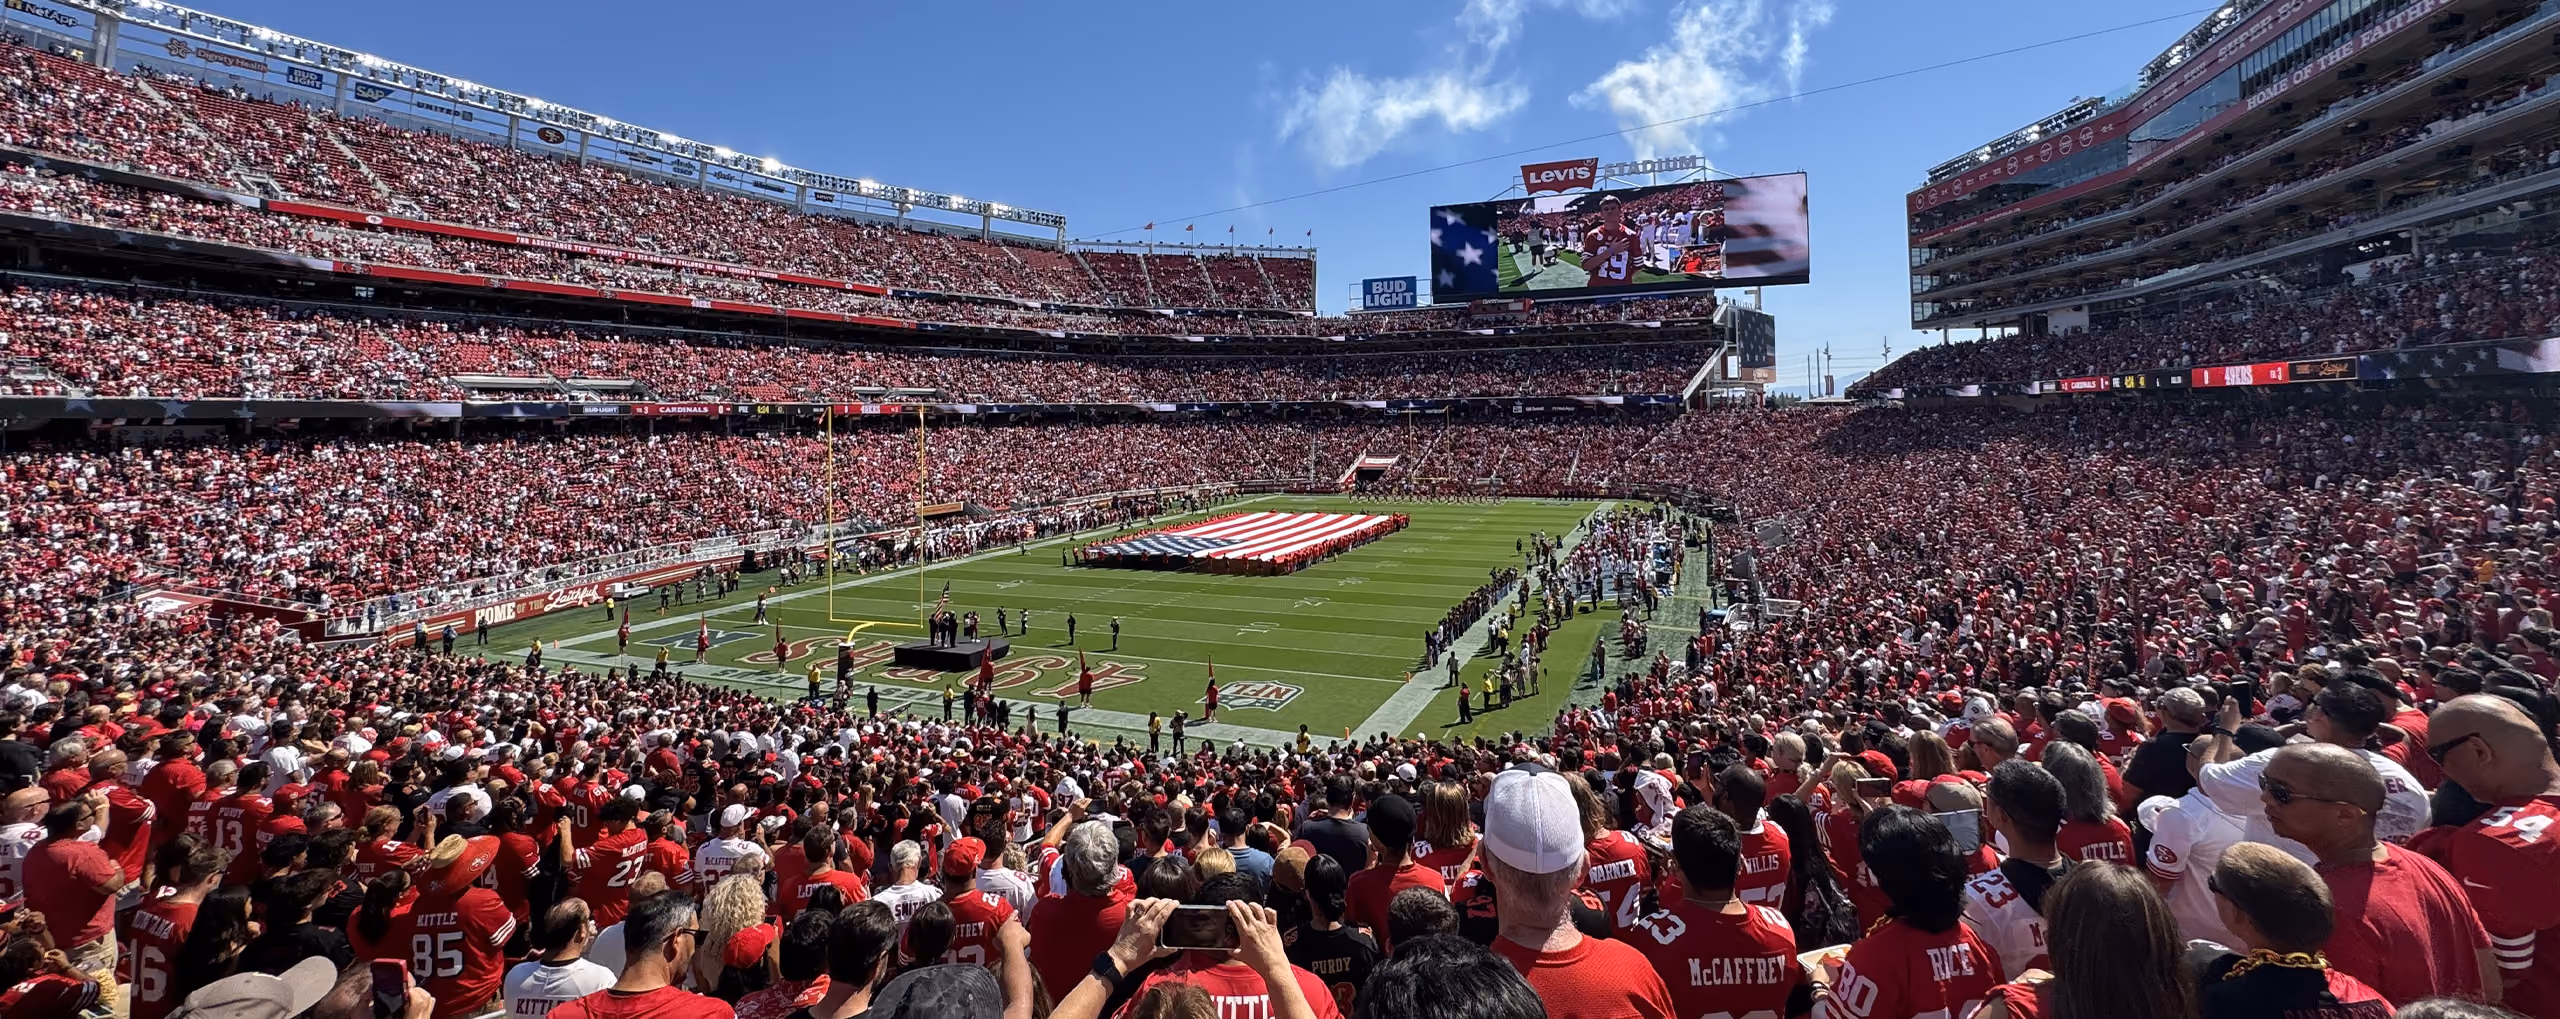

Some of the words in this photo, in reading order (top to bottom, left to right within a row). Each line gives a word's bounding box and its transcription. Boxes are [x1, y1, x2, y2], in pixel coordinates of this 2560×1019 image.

[25, 3, 78, 27] NetApp
[197, 50, 235, 67] Dignity
[235, 58, 268, 73] Health
[288, 74, 322, 90] LIGHT
[293, 68, 318, 81] BUD
[2246, 78, 2289, 111] HOME
[2293, 65, 2313, 85] OF
[2317, 41, 2354, 70] THE
[356, 84, 386, 100] SAP
[416, 101, 460, 117] UNITED
[1604, 154, 1697, 178] STADIUM
[1372, 280, 1406, 293] BUD
[1365, 291, 1414, 306] LIGHT
[2225, 365, 2254, 386] 49ERS
[659, 406, 709, 414] CARDINALS
[475, 603, 516, 628] HOME
[516, 602, 526, 614] OF
[528, 597, 545, 612] THE
[544, 584, 601, 613] Faithful
[1232, 683, 1295, 700] NFL
[218, 806, 245, 818] PURDY
[1057, 794, 1074, 808] 97
[2480, 806, 2554, 844] 54
[215, 819, 243, 859] 13
[2080, 840, 2127, 861] KITTLE
[608, 855, 644, 888] 23
[1589, 858, 1638, 885] WARNER
[1744, 853, 1780, 876] WILLIS
[1969, 873, 2019, 909] 23
[416, 912, 459, 928] KITTLE
[1638, 908, 1687, 945] 23
[412, 931, 465, 978] 85
[1311, 956, 1352, 974] PURDY
[1926, 942, 1975, 982] RICE
[130, 937, 168, 1003] 16
[1687, 954, 1787, 987] McCAFFREY
[1838, 960, 1879, 1018] 80
[1210, 994, 1276, 1019] ITTL
